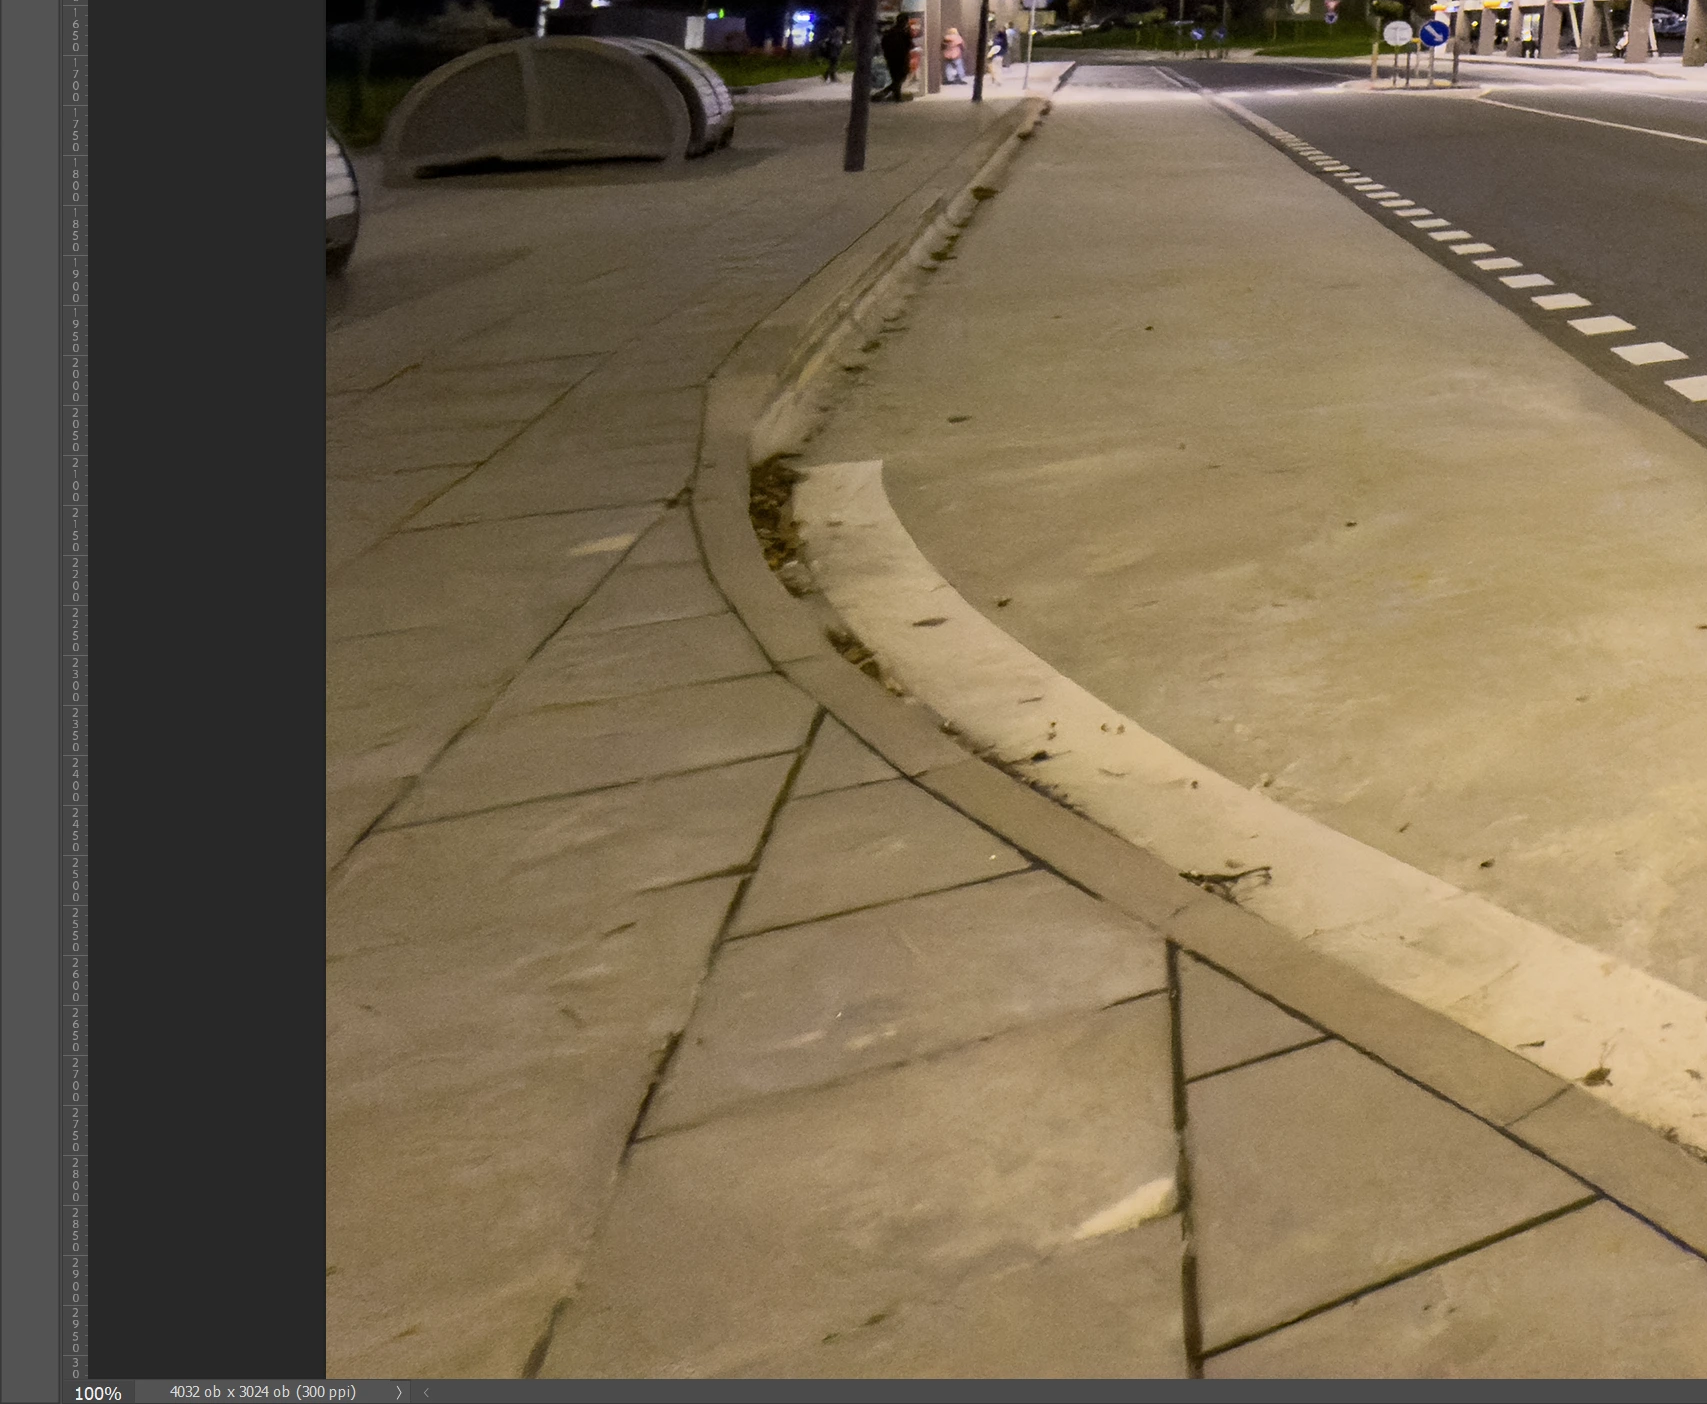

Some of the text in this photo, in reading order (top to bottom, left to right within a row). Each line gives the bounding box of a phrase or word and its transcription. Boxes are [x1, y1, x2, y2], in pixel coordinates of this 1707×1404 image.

[76, 1387, 121, 1400] 100%
[170, 1385, 355, 1400] 4032 ob x 3024 ob (300 ppi)
